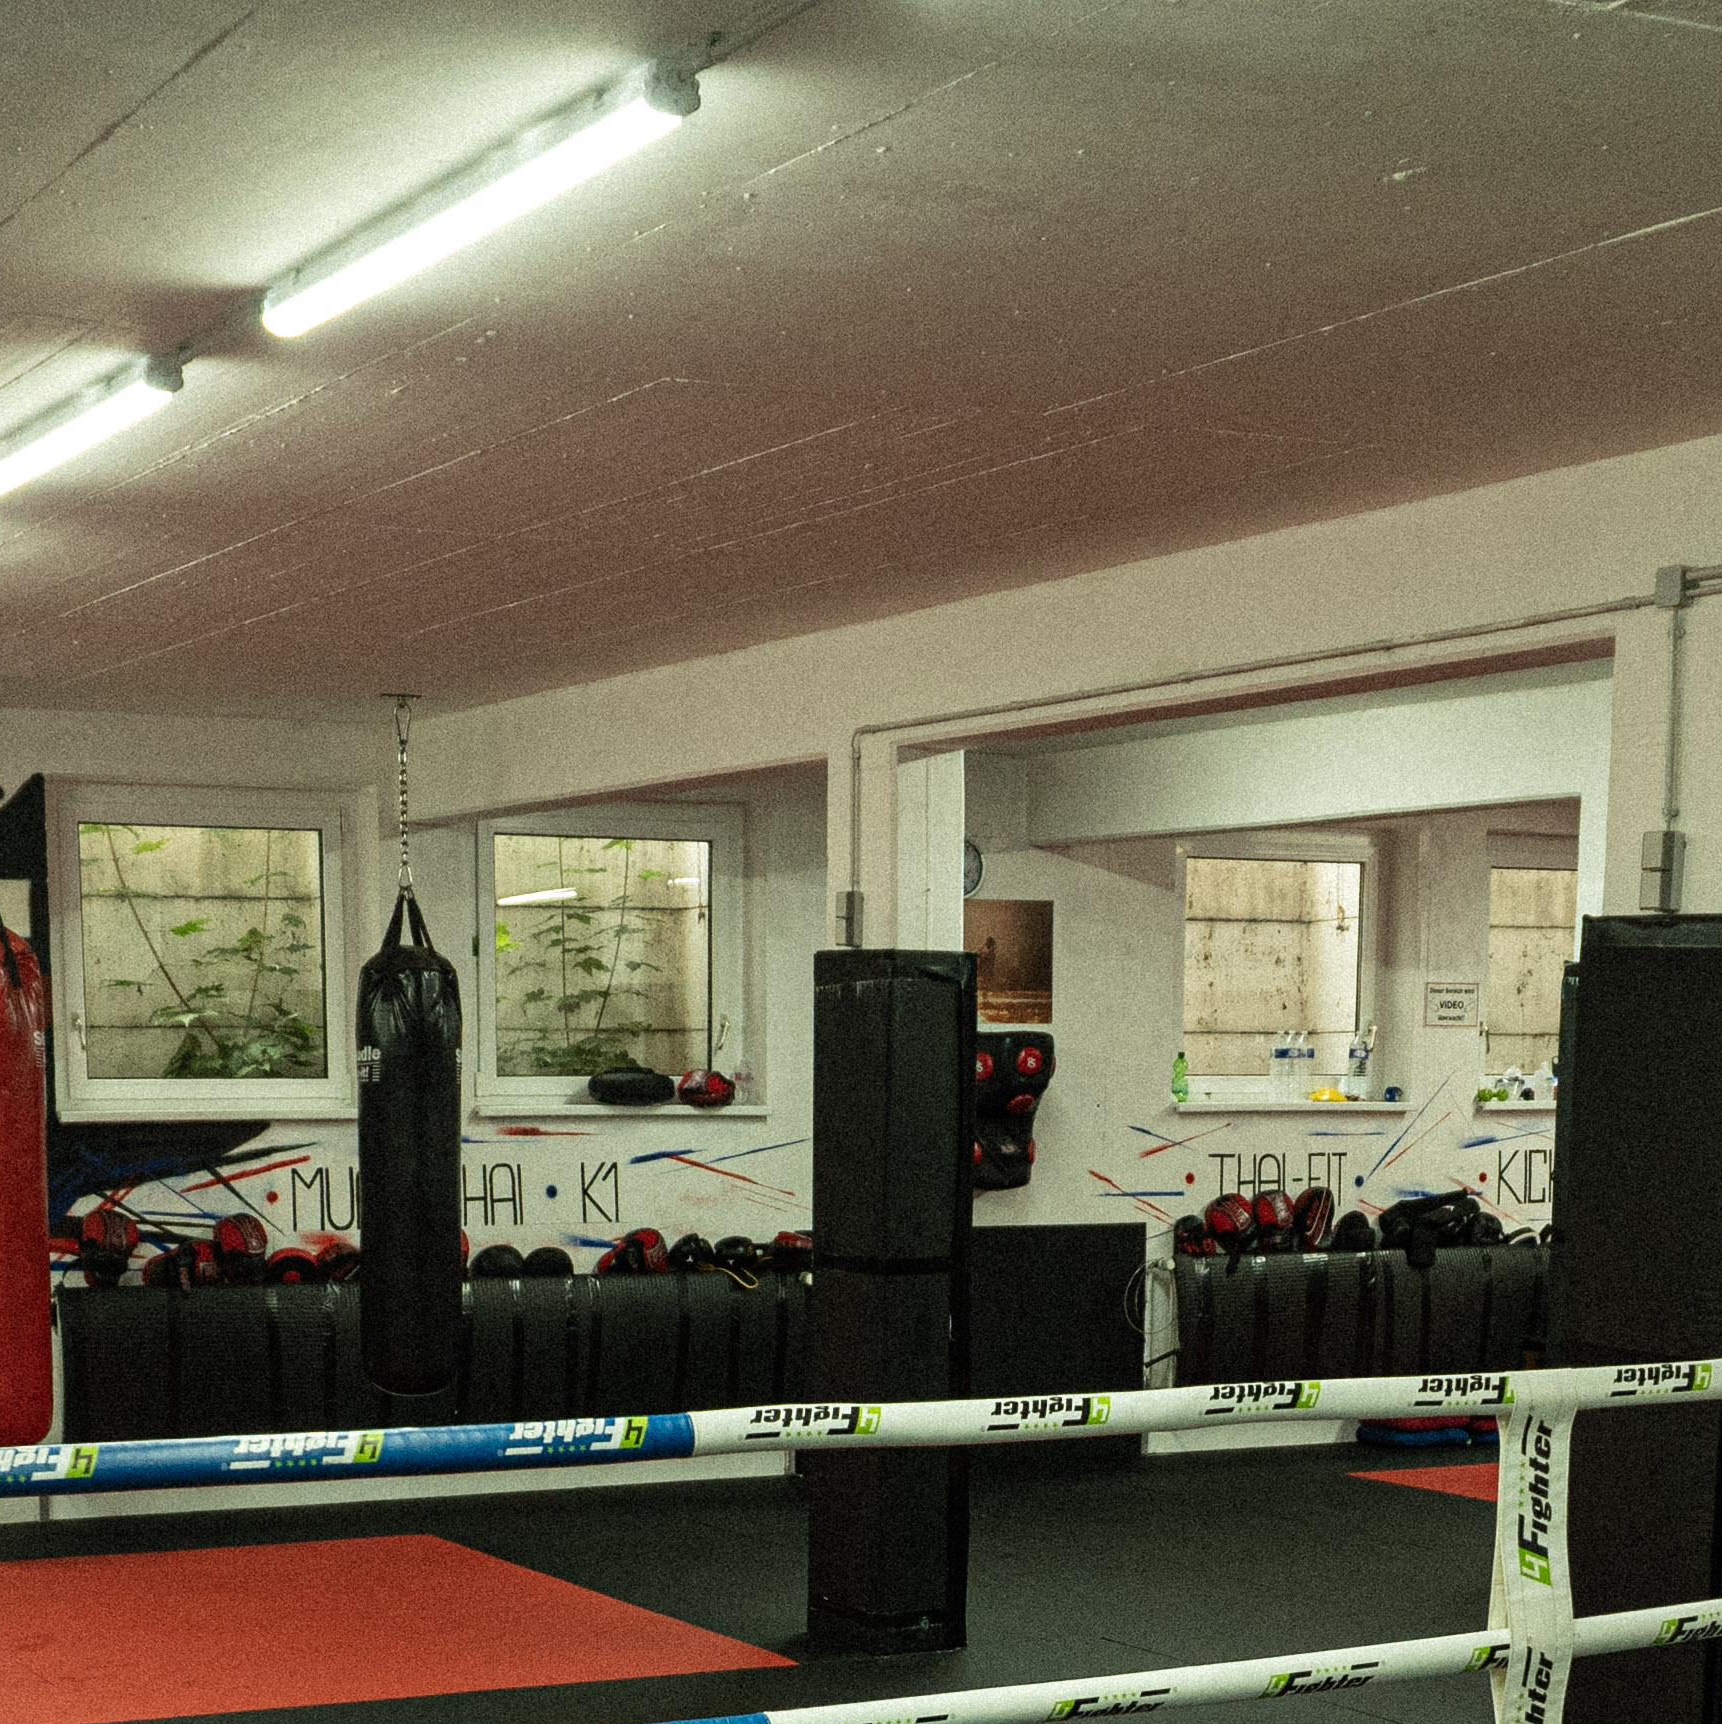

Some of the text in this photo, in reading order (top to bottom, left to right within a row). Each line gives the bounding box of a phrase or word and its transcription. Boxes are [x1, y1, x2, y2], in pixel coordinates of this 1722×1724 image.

[1440, 1001, 1464, 1009] VIDEO
[291, 1162, 620, 1232] MU HAI K1
[1497, 1149, 1554, 1204] KIC
